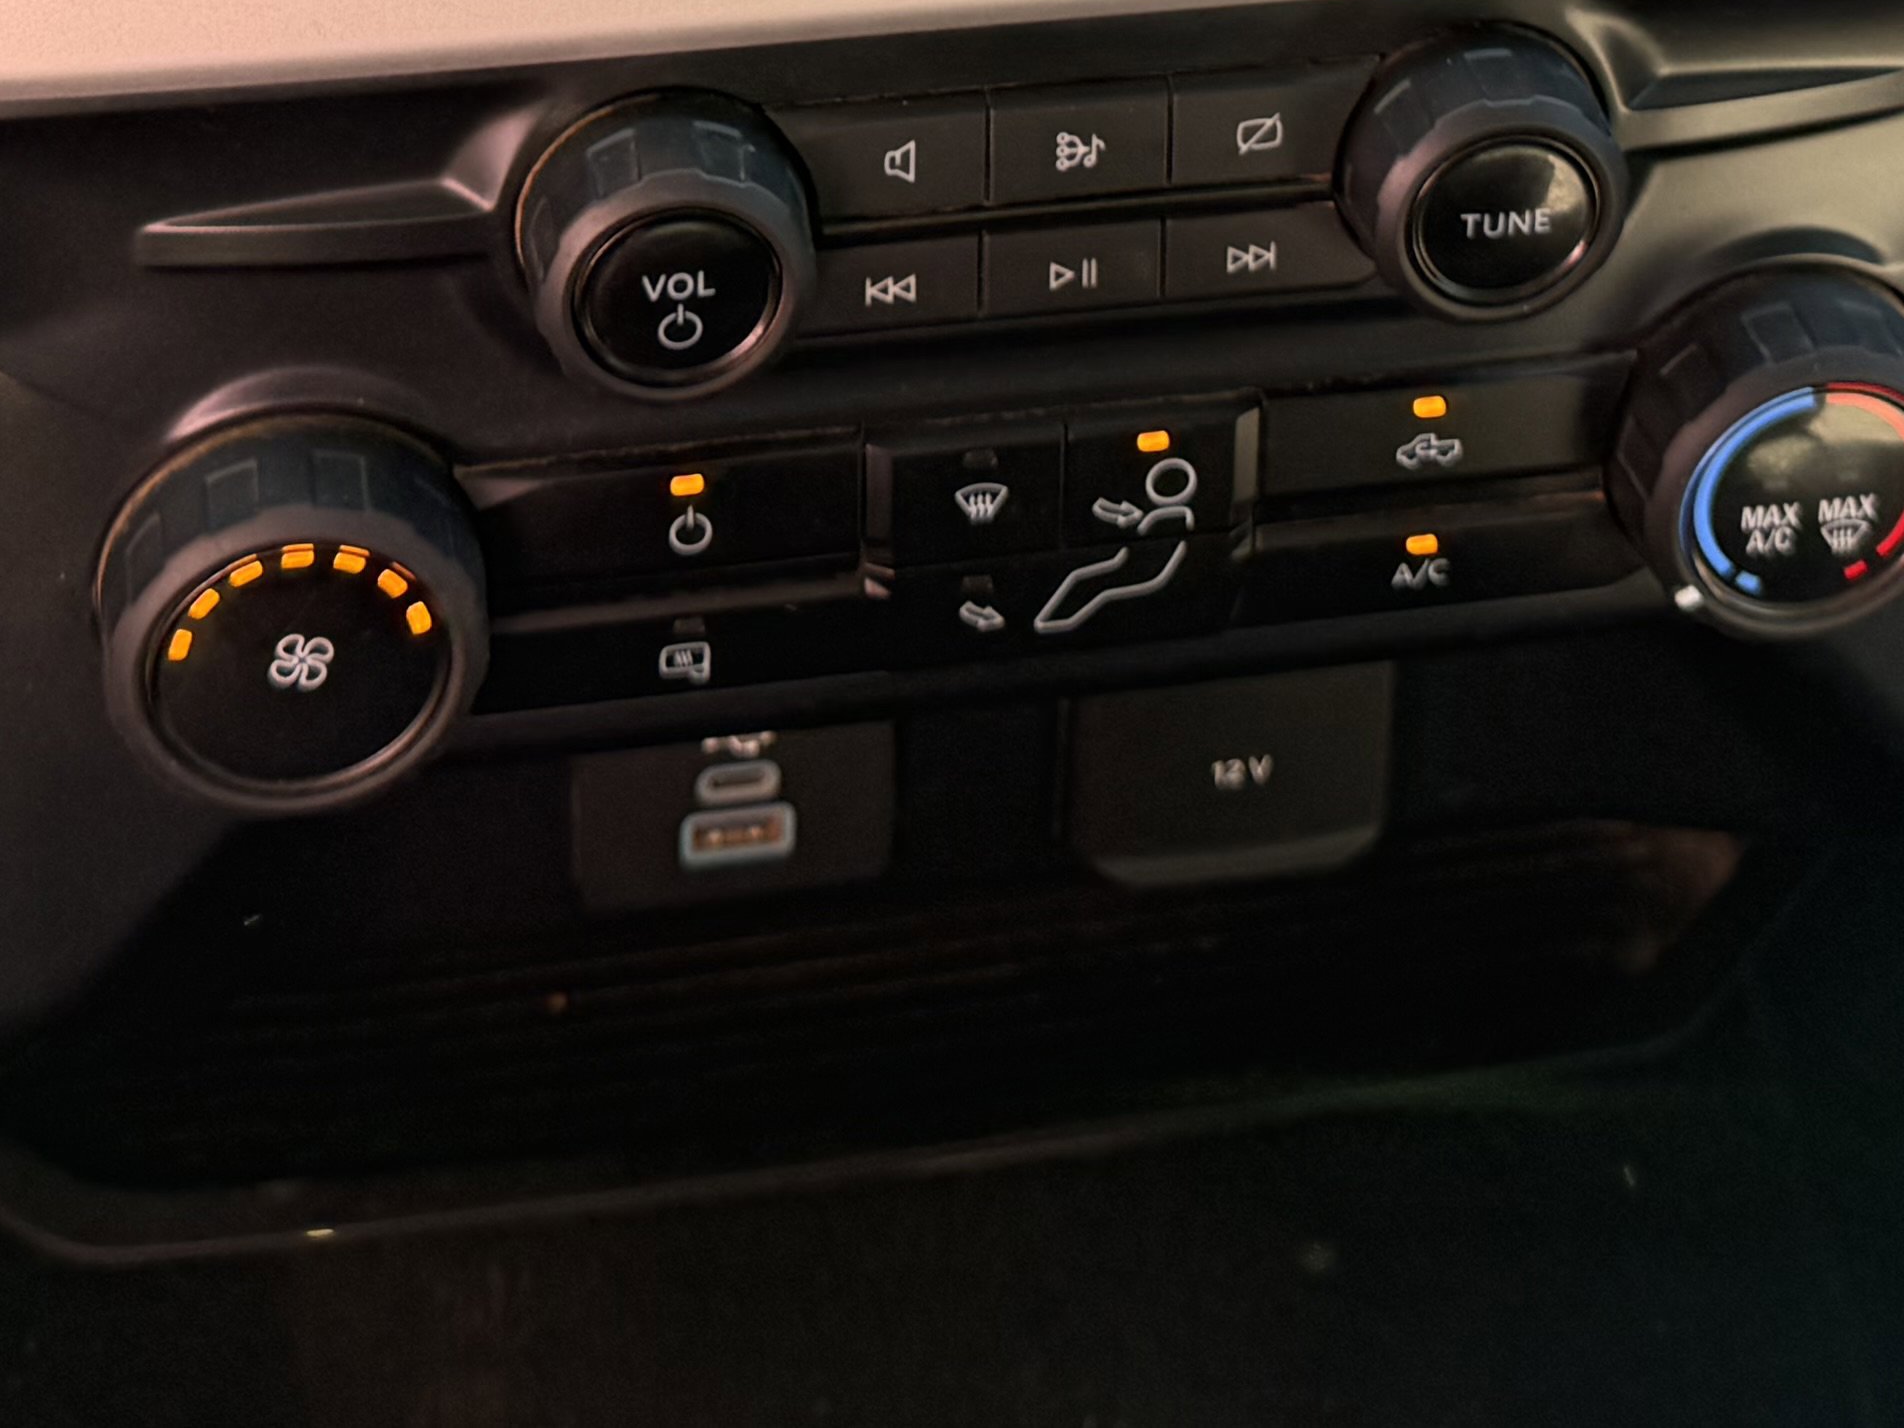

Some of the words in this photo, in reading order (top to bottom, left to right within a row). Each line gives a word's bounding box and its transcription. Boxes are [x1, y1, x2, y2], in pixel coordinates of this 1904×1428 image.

[1460, 206, 1553, 239] TUNE
[641, 270, 716, 303] VOL
[1741, 501, 1802, 533] MAX
[1818, 493, 1880, 523] MAX
[1746, 525, 1795, 556] A/C
[1391, 557, 1451, 590] A/C
